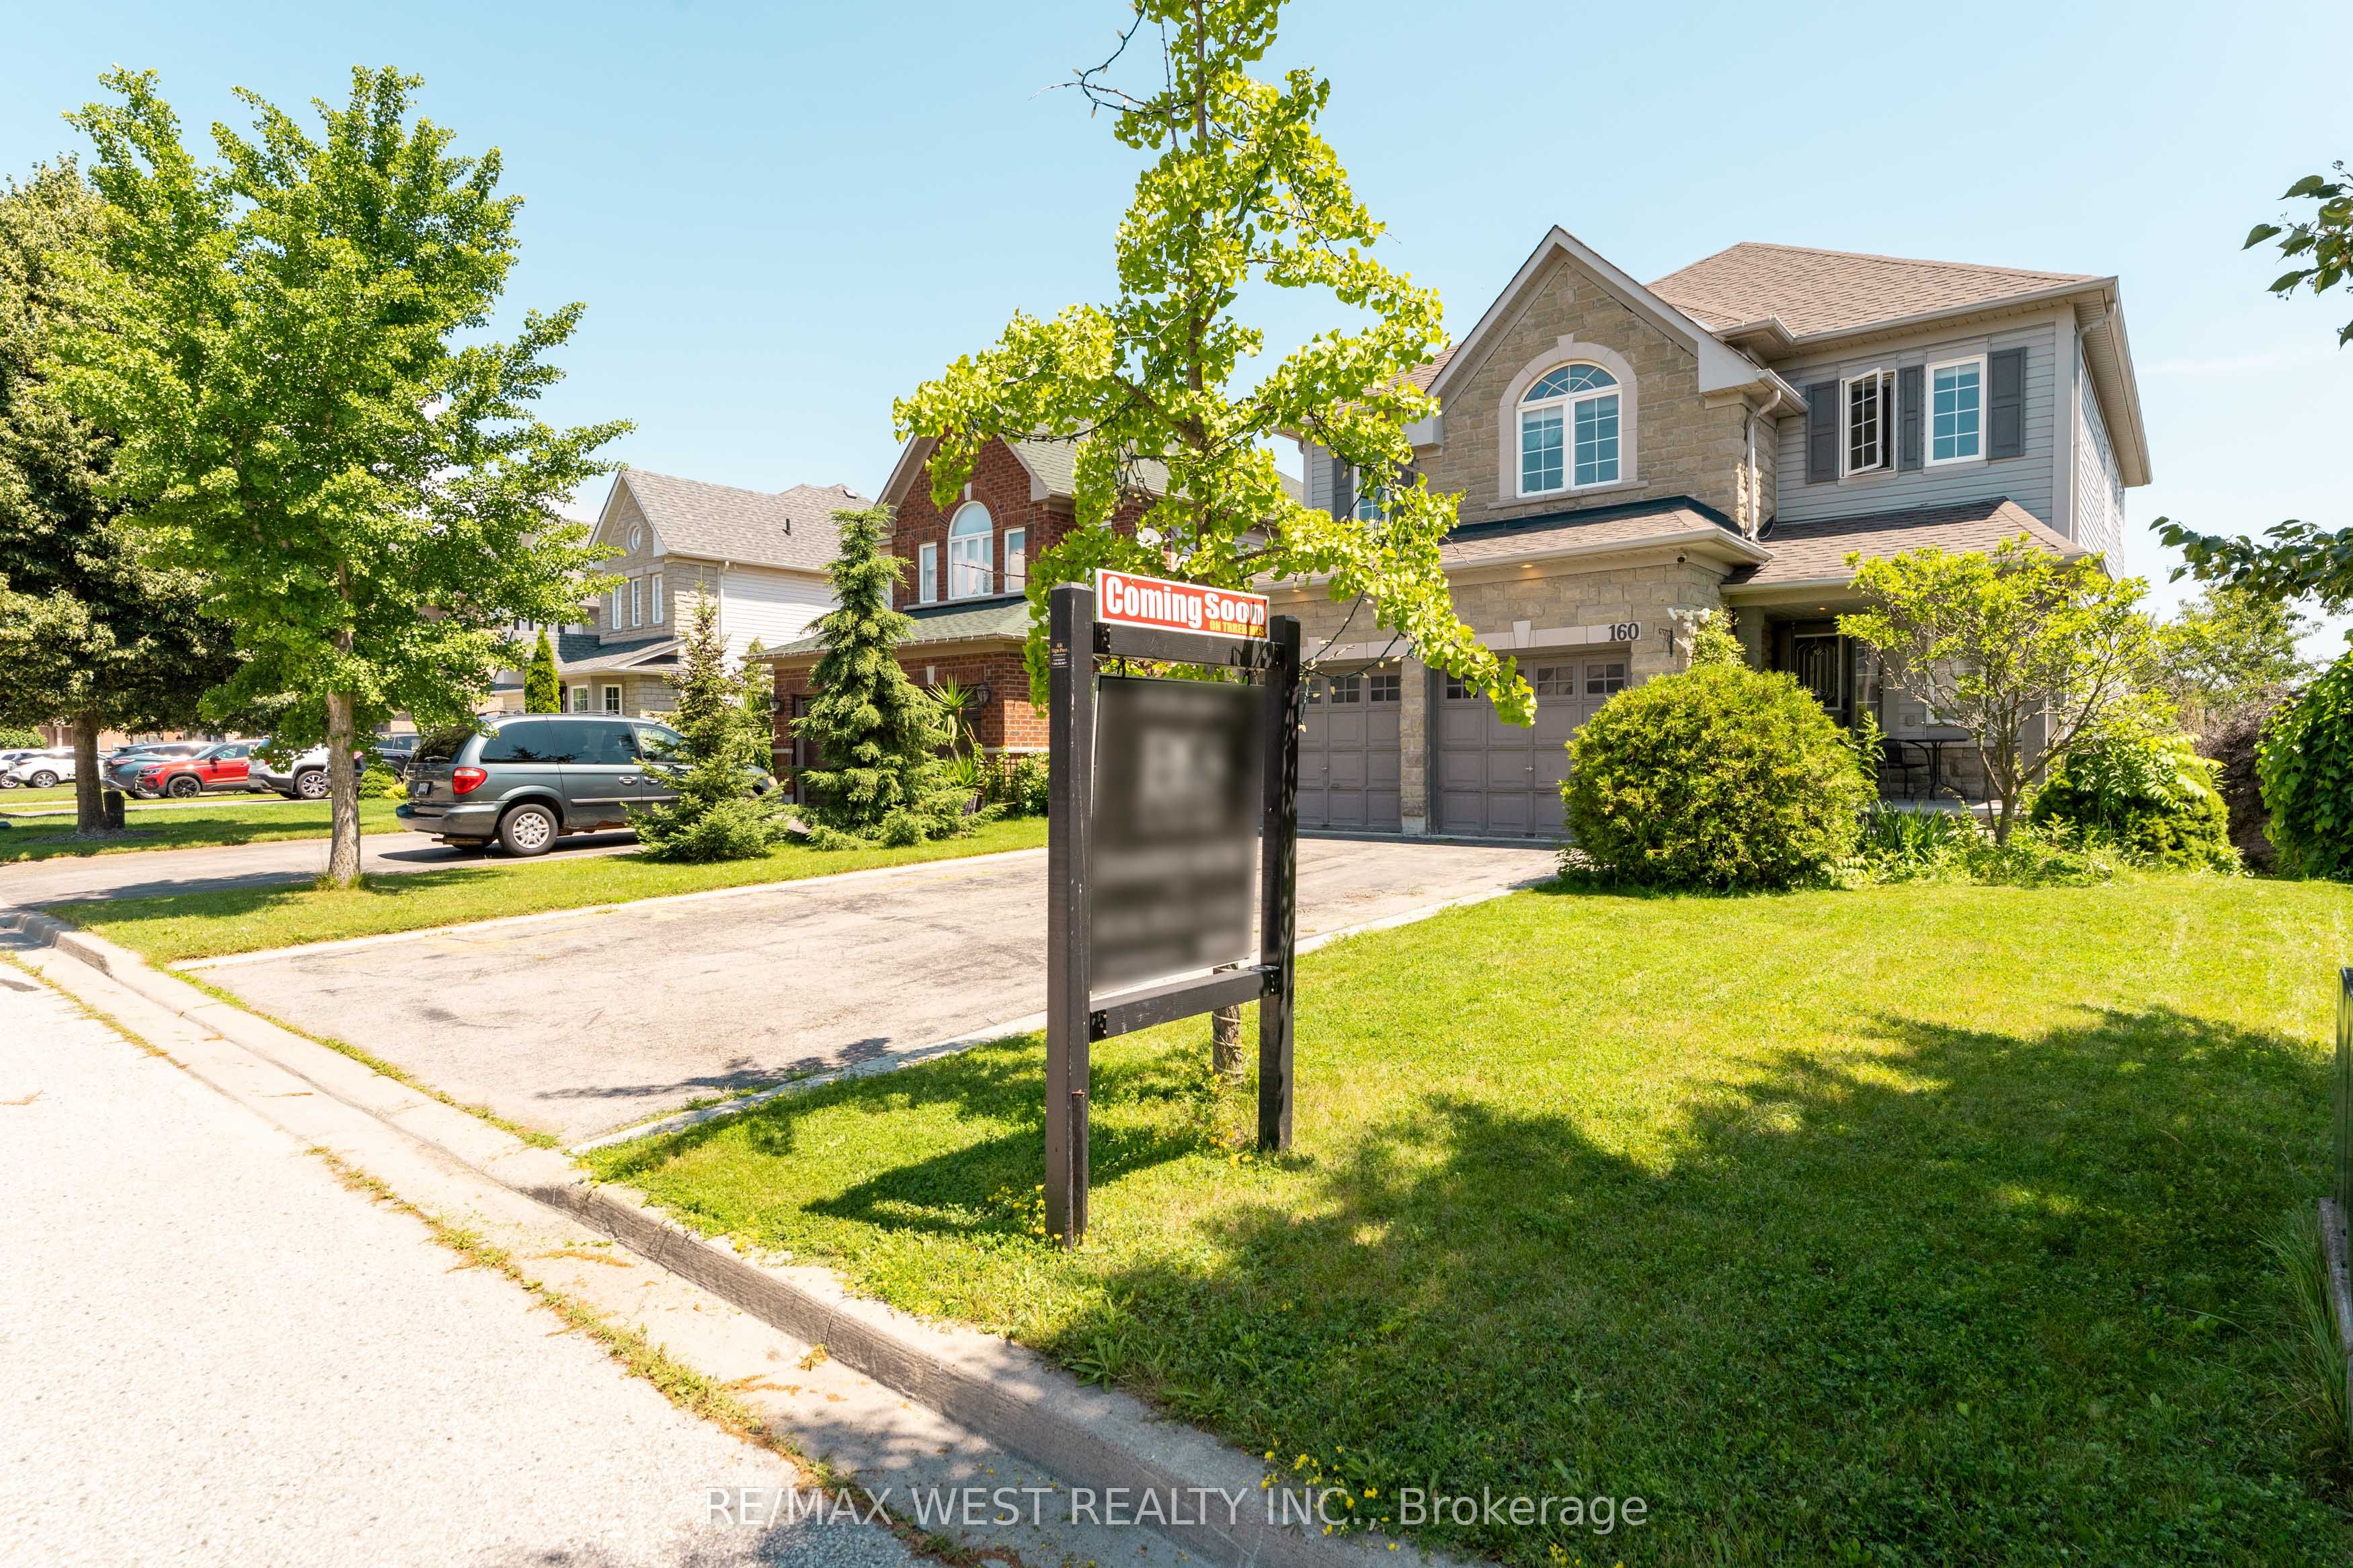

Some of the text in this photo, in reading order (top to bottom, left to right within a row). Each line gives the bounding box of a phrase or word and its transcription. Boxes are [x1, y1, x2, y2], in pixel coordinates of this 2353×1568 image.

[1106, 576, 1264, 629] Coming Soon
[1209, 620, 1221, 632] ON
[1222, 622, 1248, 635] TRREB
[1608, 623, 1639, 641] 160
